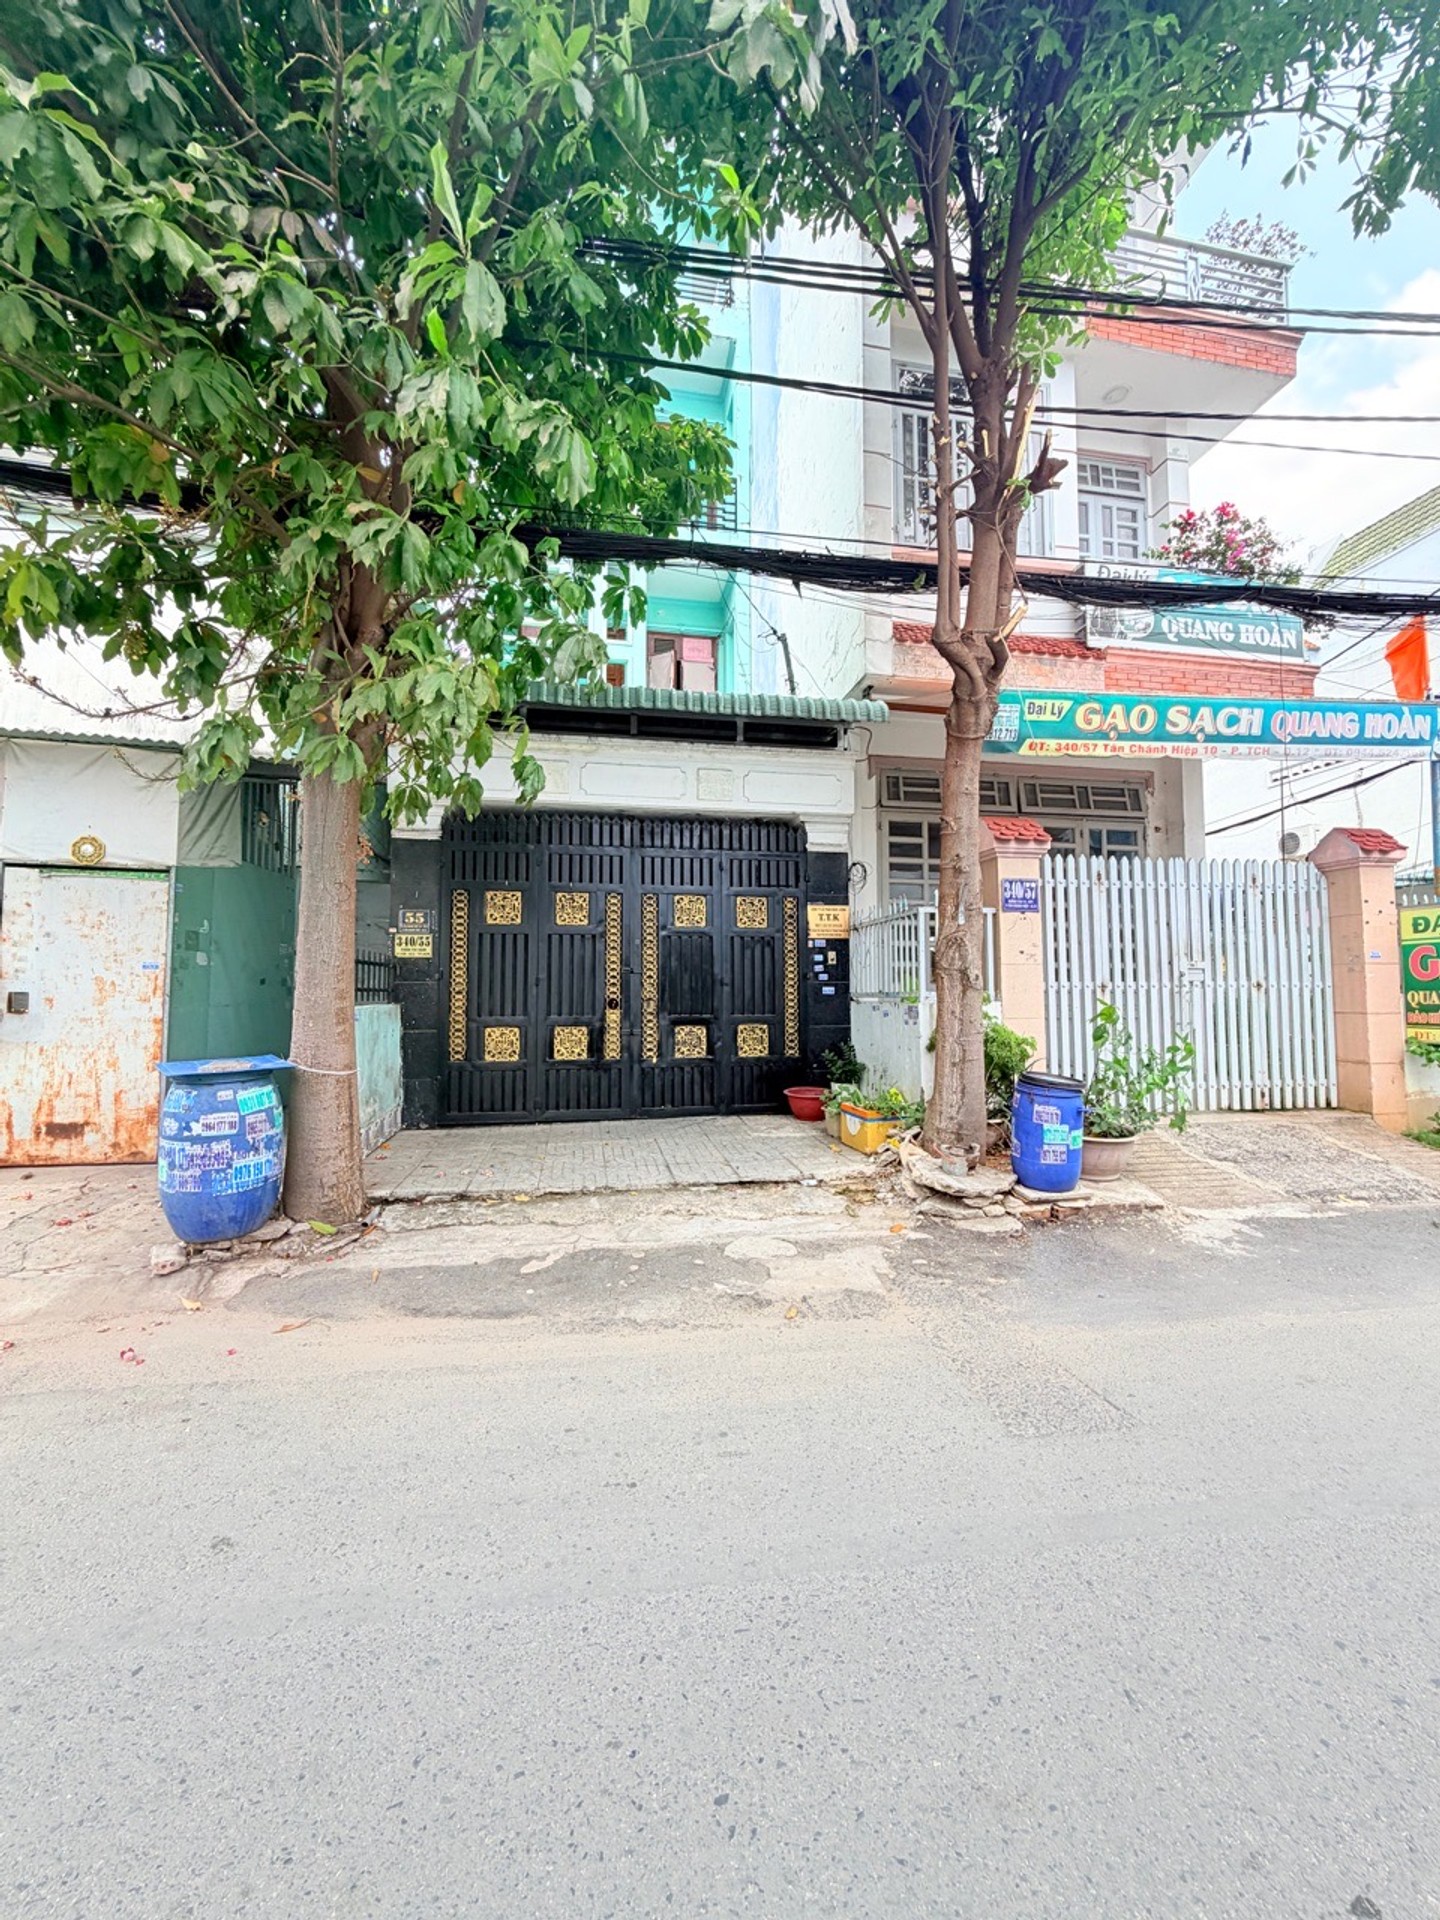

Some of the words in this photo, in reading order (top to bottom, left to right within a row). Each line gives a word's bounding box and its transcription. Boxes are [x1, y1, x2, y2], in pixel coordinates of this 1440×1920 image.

[1161, 615, 1235, 642] QUANG
[1239, 622, 1297, 649] HOÀN
[1027, 702, 1047, 719] Đại
[1050, 703, 1064, 719] Lý
[1075, 702, 1157, 741] GẠO
[1165, 704, 1264, 743] SẠCH
[1271, 709, 1360, 743] QUANG
[1364, 706, 1431, 741] HOÀN
[1054, 743, 1098, 753] 340/57
[1103, 742, 1125, 754] Tân
[1129, 743, 1169, 755] Chánh
[1171, 745, 1198, 757] Hiệp
[1247, 746, 1270, 756] TCH
[405, 912, 425, 924] 55
[1407, 991, 1440, 1008] QUA
